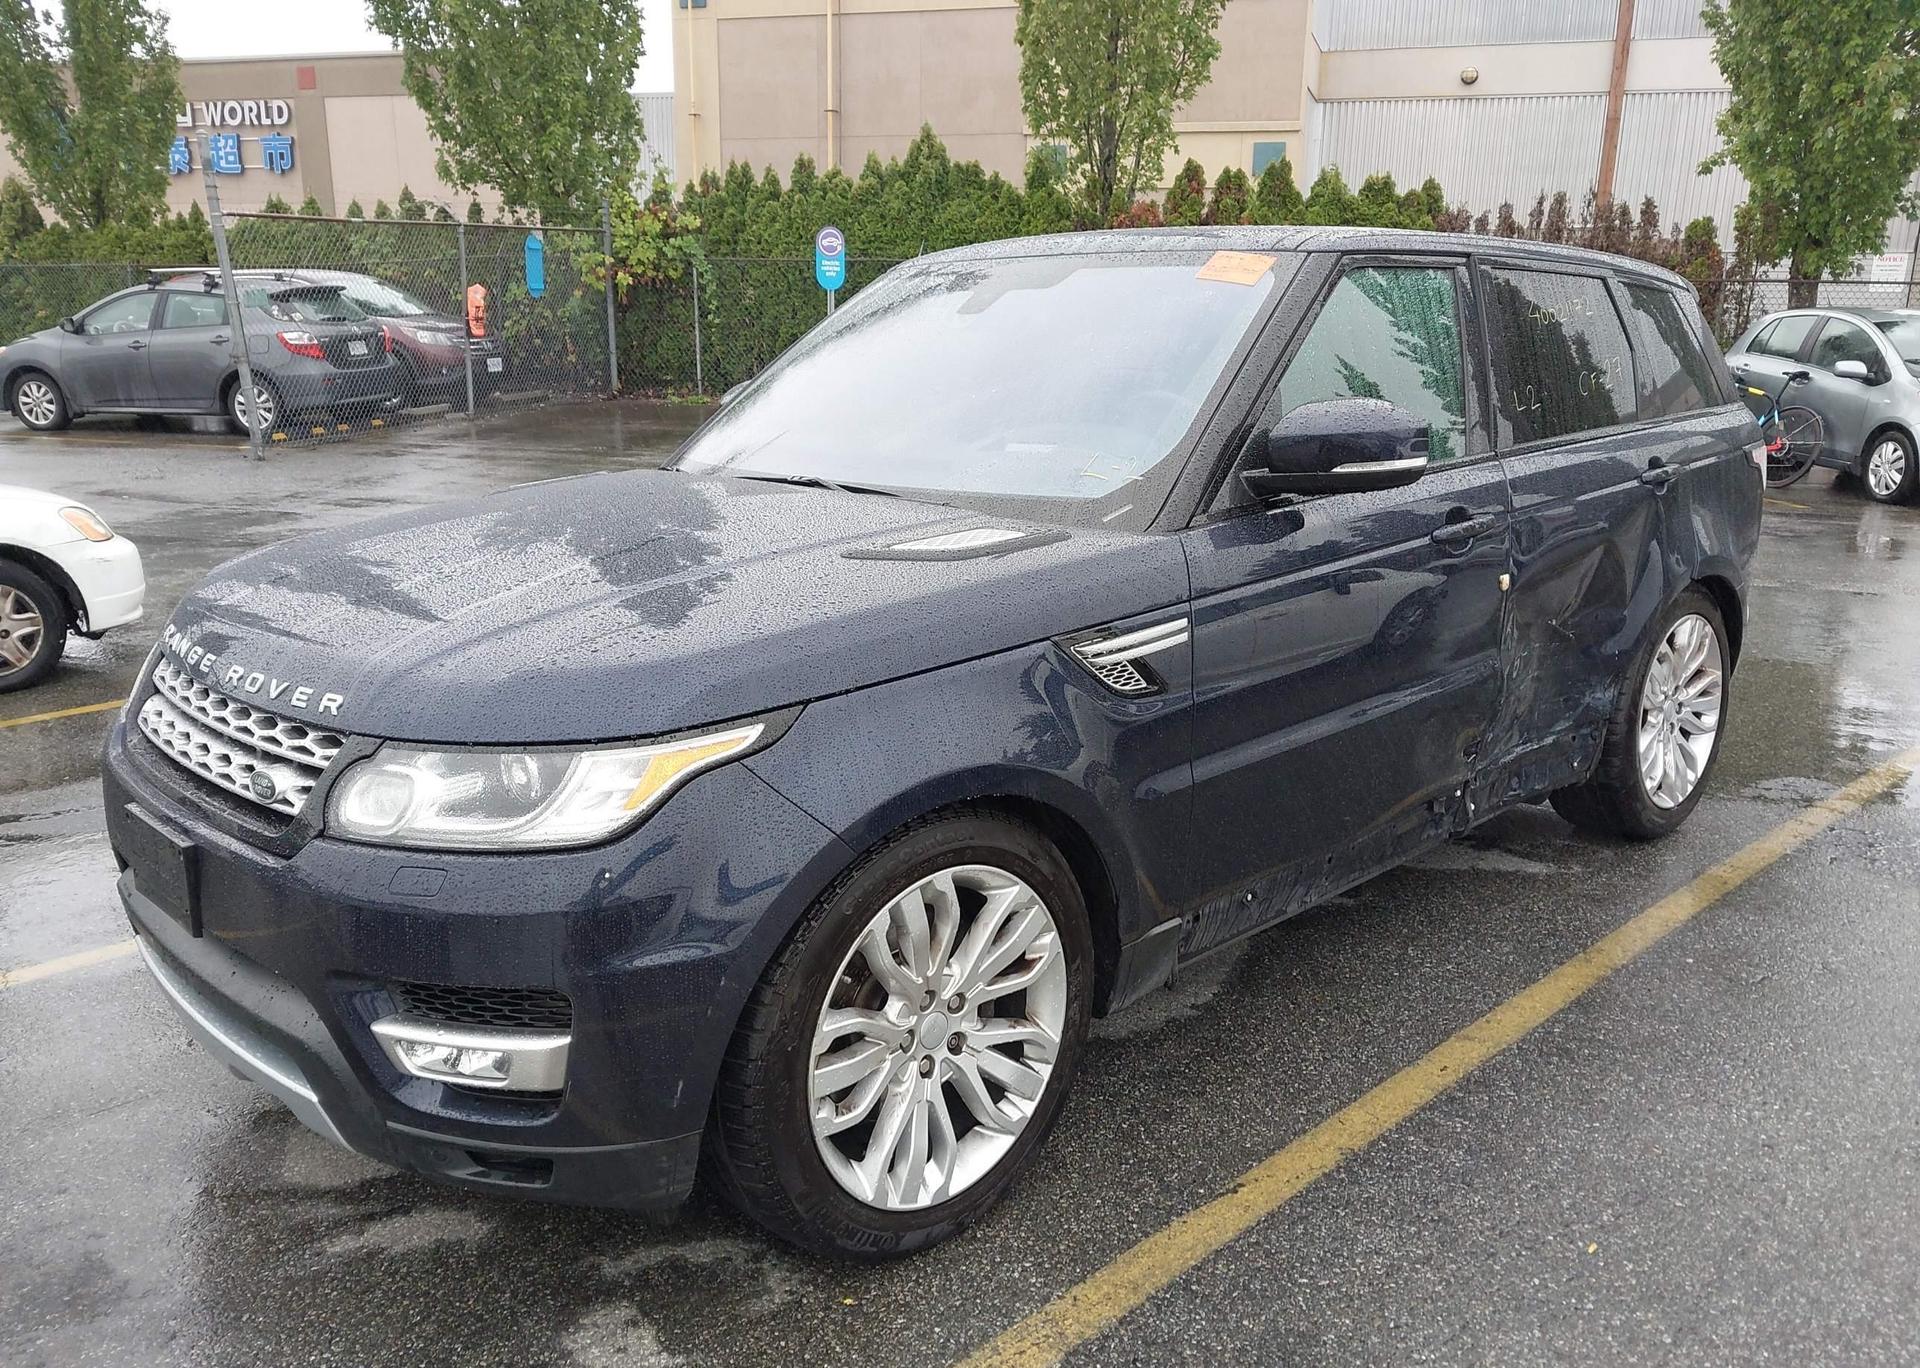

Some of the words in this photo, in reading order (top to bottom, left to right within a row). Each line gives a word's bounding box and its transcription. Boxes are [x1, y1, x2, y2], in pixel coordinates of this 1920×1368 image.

[202, 100, 289, 126] WORLD
[163, 623, 217, 673] RANGE
[225, 664, 344, 716] ROVER
